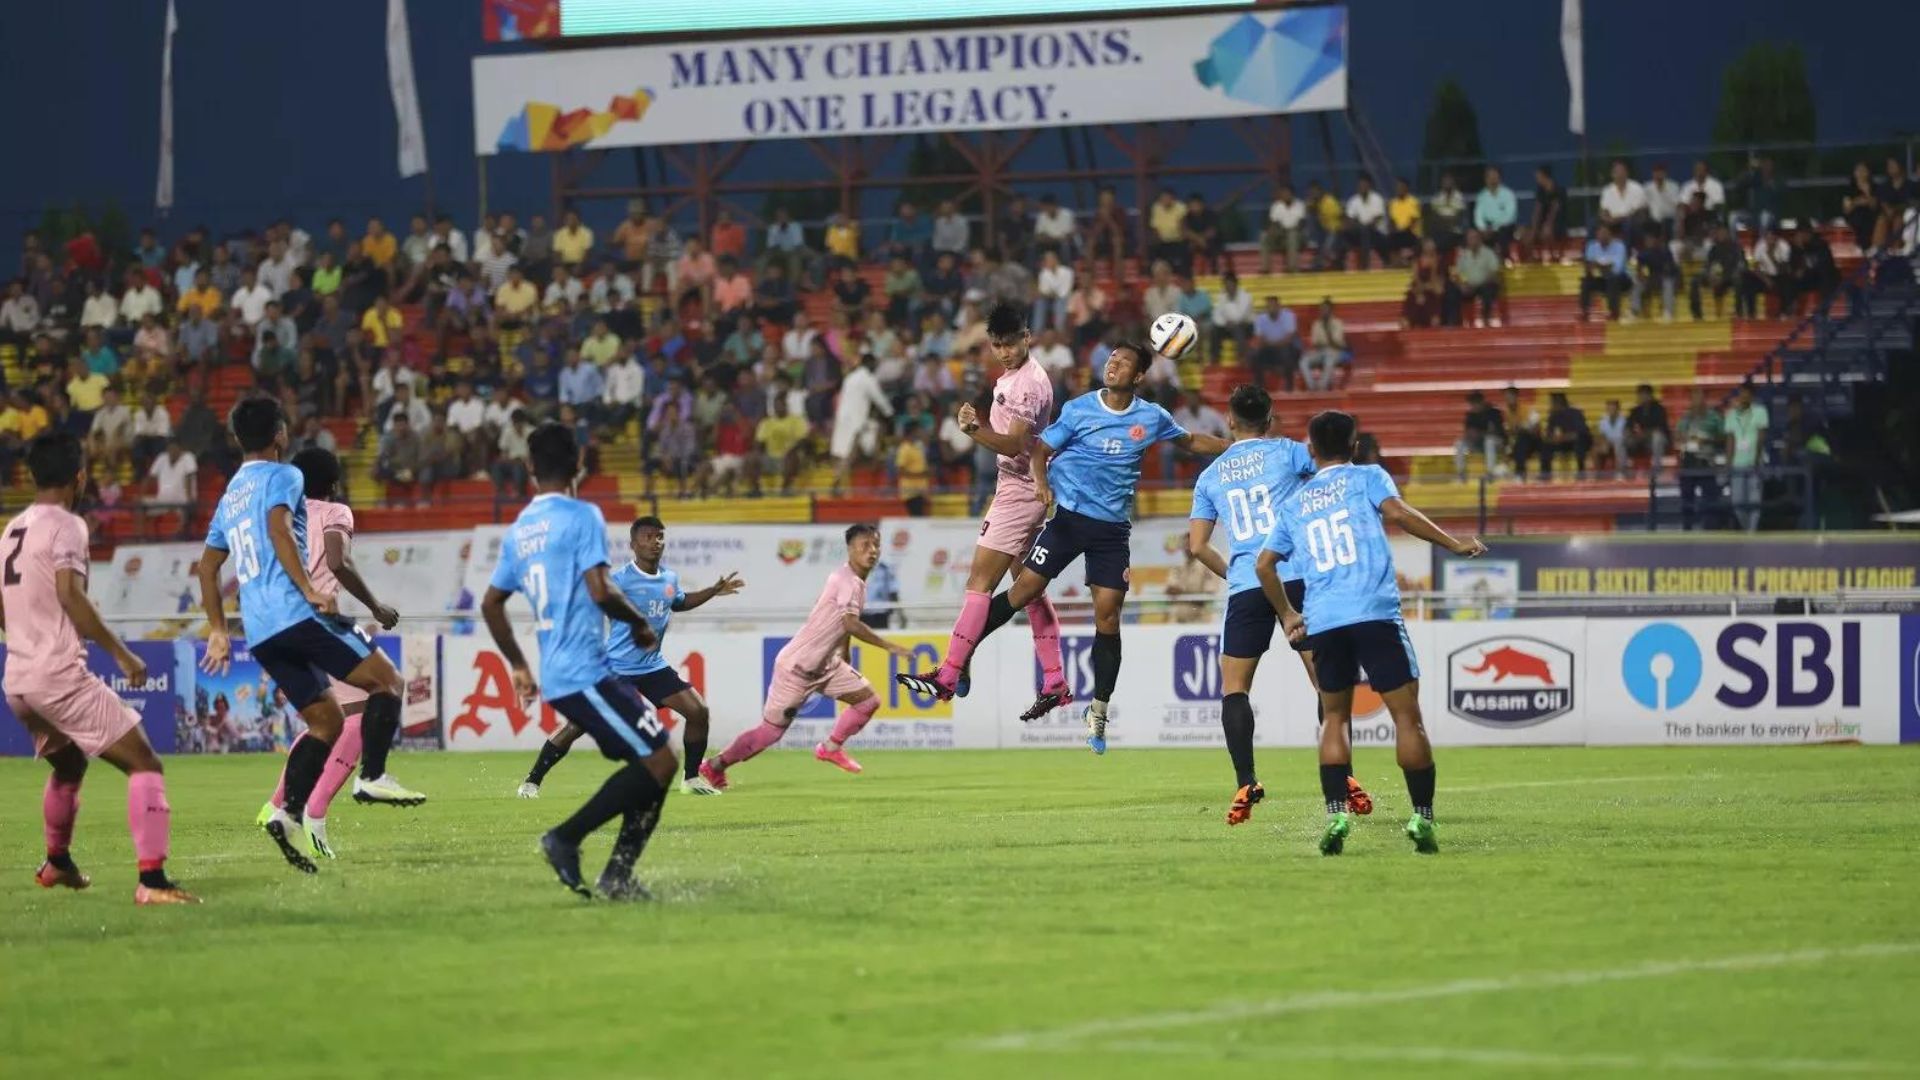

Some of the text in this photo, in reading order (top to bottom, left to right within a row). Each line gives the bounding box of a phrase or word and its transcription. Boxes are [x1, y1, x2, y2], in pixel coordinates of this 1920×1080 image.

[670, 28, 1142, 88] MANY CHAMPIONS.
[743, 84, 1069, 133] ONE LEGACY.
[1102, 437, 1122, 455] 15
[1218, 450, 1265, 472] INDIAN
[1219, 463, 1265, 485] ARMY
[1300, 477, 1347, 503] INDIAN
[1301, 488, 1346, 517] ARMY
[1227, 484, 1275, 541] 03
[1307, 509, 1357, 573] 05
[4, 527, 28, 586] 2
[1031, 545, 1049, 565] 15
[1537, 567, 1915, 594] INTER SIXTH SCHEDULE PREMIER LEAGUE
[648, 600, 664, 618] 34
[1715, 622, 1861, 709] SBI
[1461, 691, 1562, 711] Assam Oil
[1665, 722, 1692, 737] The
[1696, 721, 1746, 737] banker
[1750, 722, 1765, 737] to
[1769, 725, 1811, 741] every
